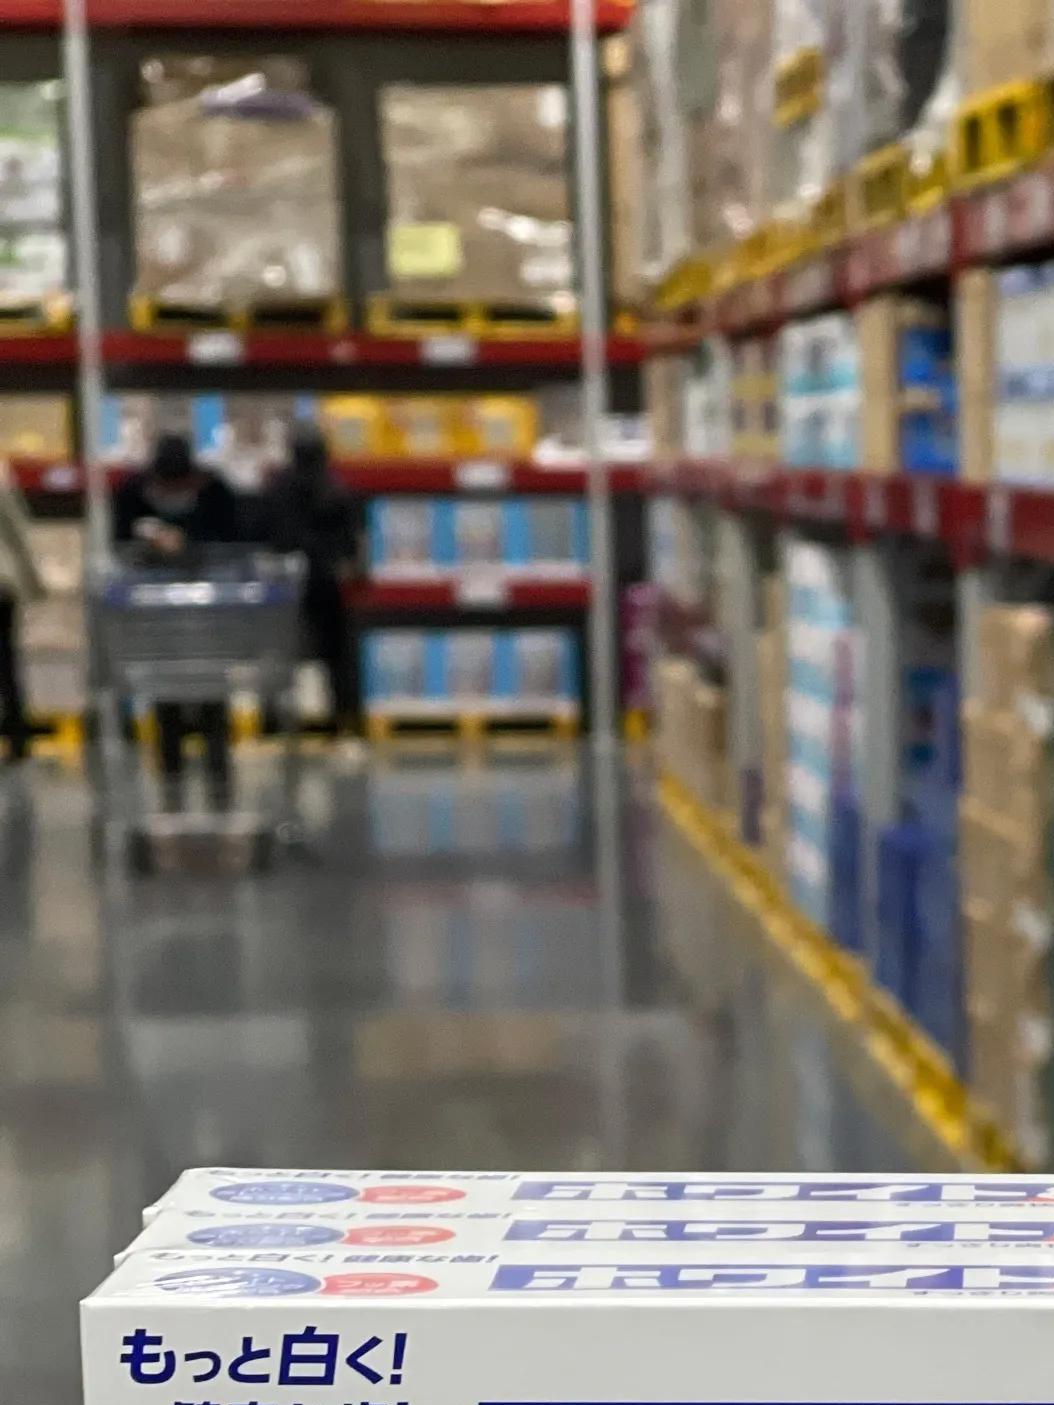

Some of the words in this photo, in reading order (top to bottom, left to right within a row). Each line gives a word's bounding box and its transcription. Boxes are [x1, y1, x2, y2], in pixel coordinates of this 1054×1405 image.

[120, 1326, 408, 1386] もっと白く!
